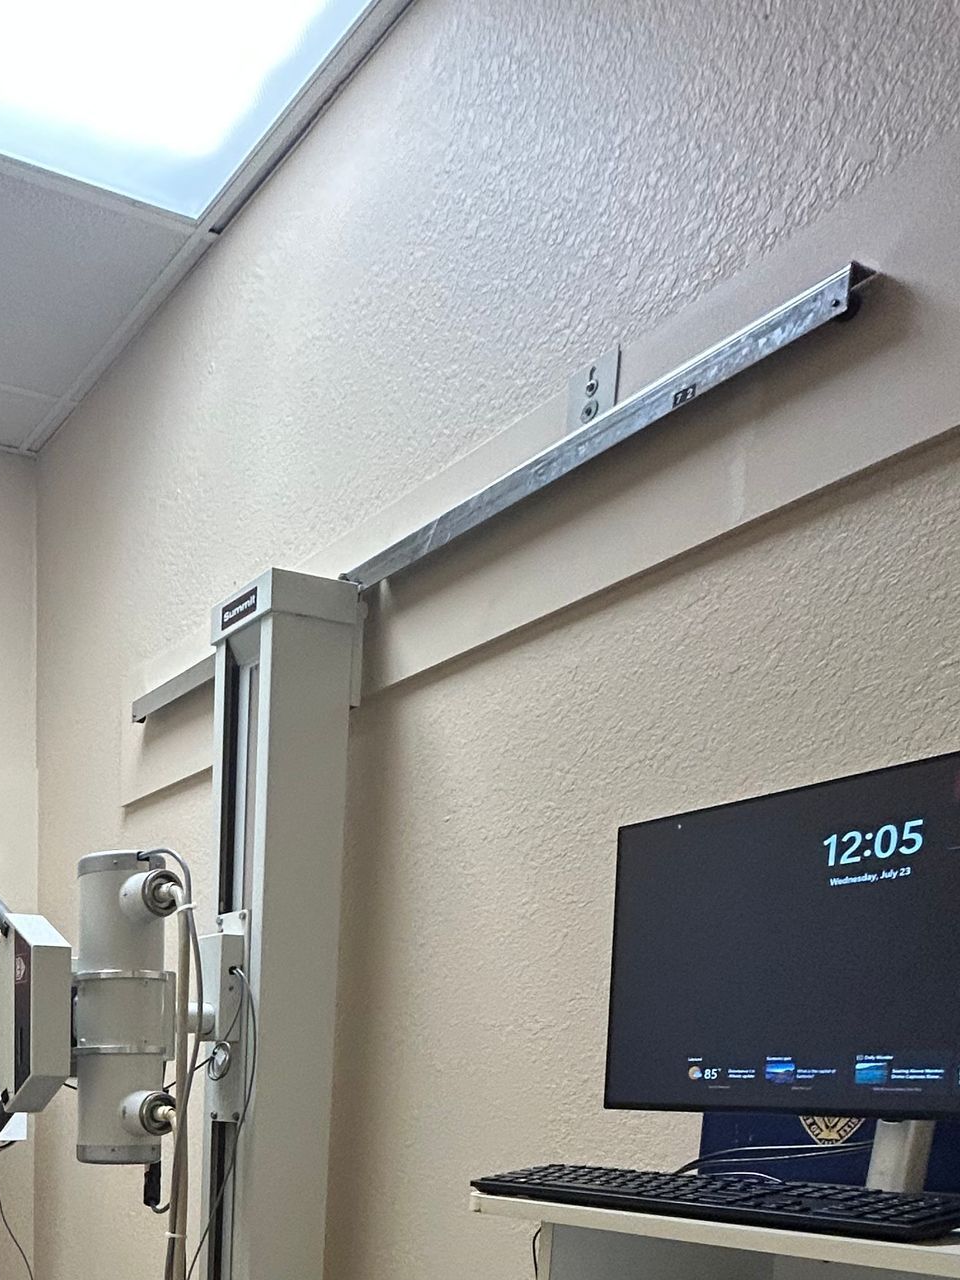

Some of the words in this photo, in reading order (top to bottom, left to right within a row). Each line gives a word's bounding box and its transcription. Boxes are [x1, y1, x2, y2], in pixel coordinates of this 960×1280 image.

[223, 594, 256, 623] Summit
[823, 819, 924, 867] 12:05
[829, 873, 879, 887] Wednesday,
[880, 870, 898, 881] July
[899, 866, 912, 877] 23
